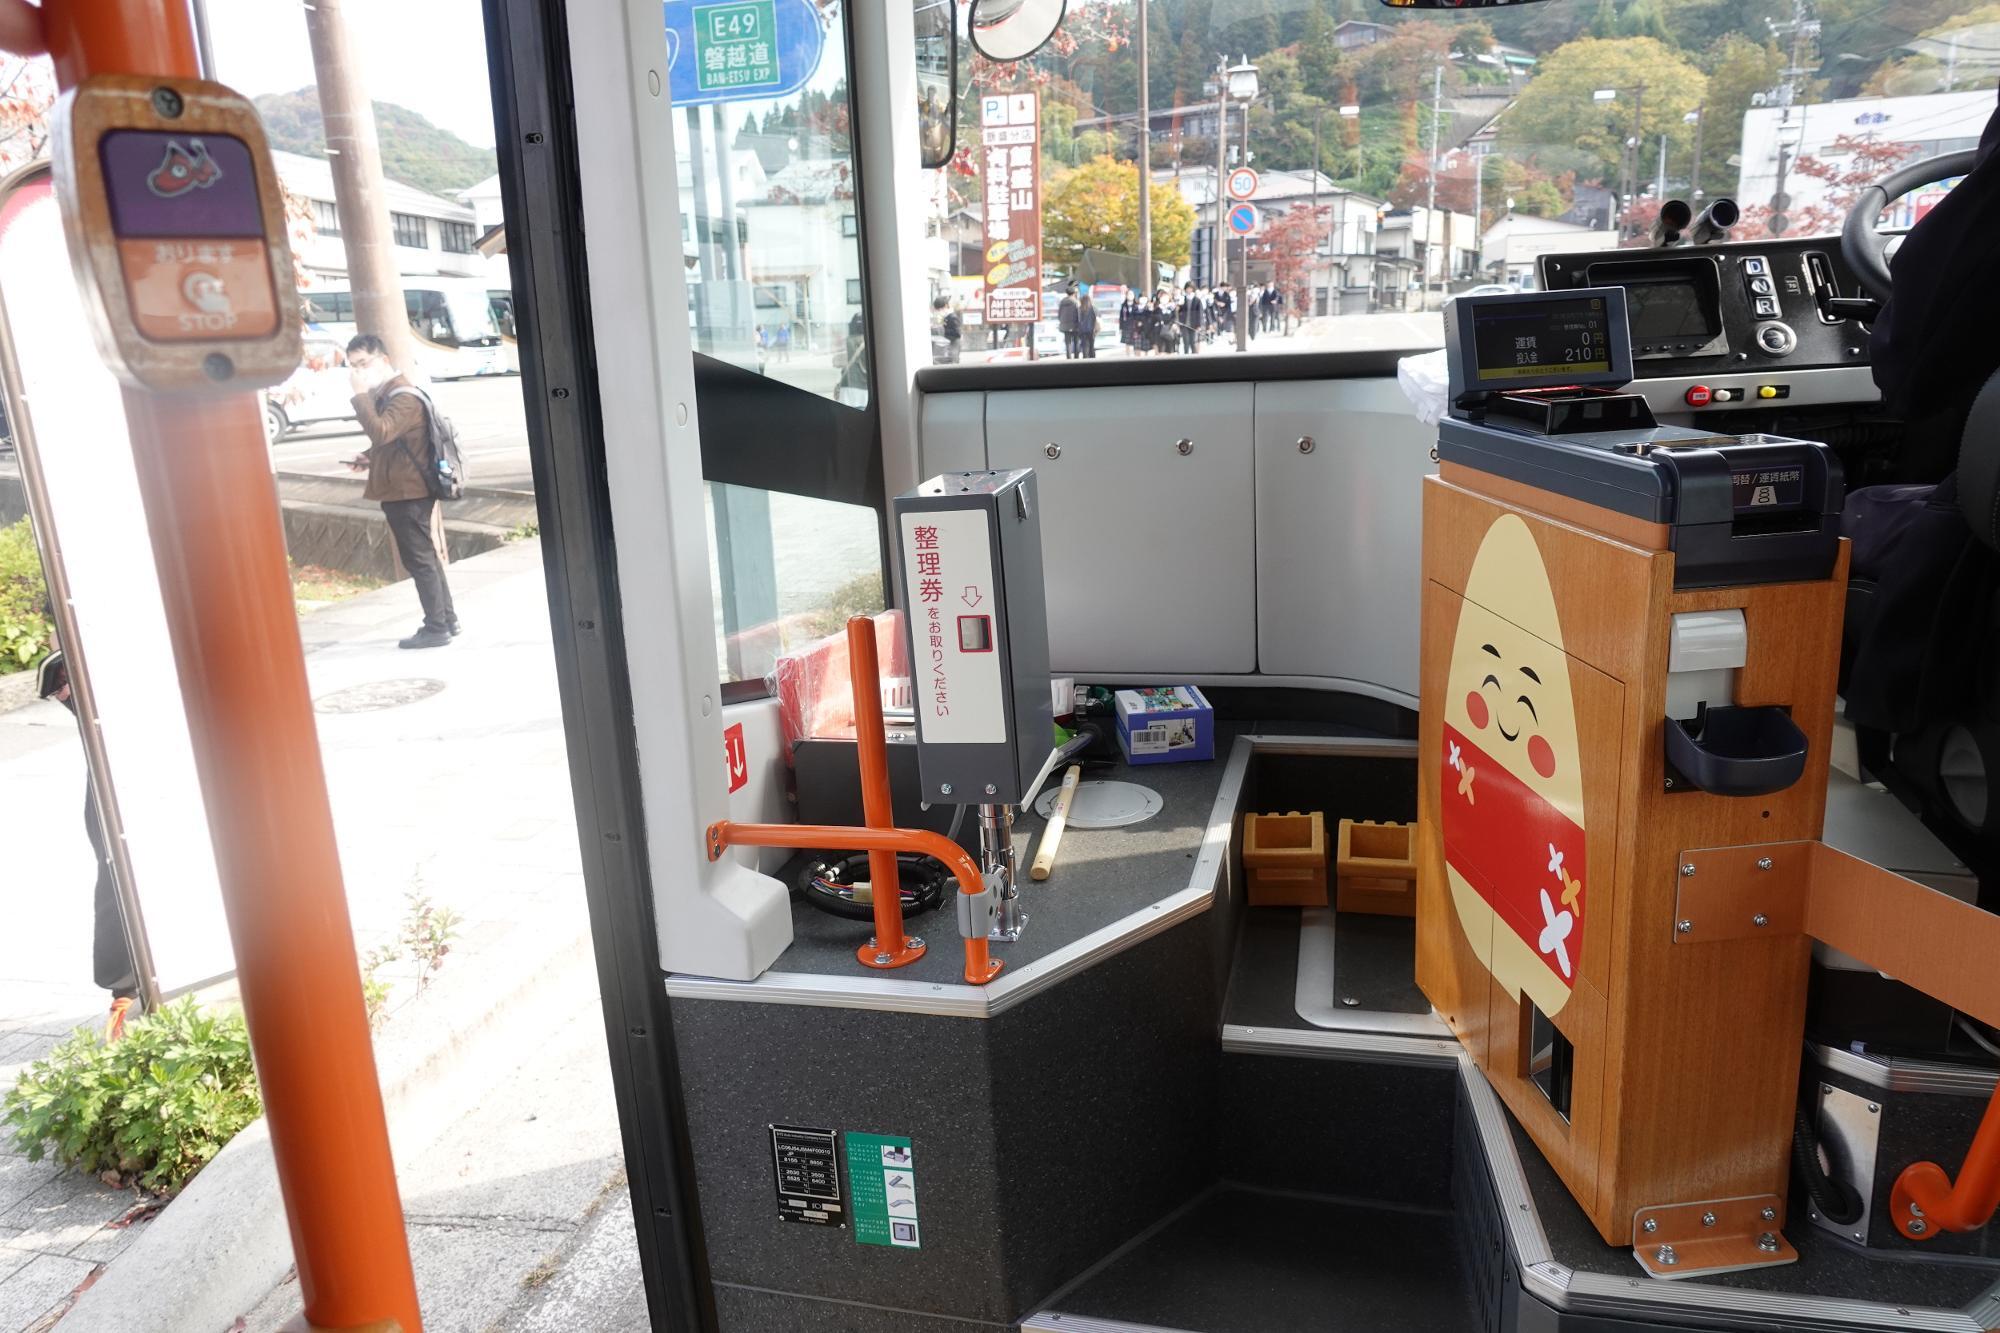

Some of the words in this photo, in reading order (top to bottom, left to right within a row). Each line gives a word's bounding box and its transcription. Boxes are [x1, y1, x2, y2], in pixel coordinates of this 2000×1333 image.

[714, 13, 755, 37] E49
[704, 42, 770, 71] 磐越道
[706, 69, 750, 86] BAN-ETSU
[753, 67, 770, 82] EXP
[1234, 176, 1252, 191] 50
[1751, 261, 1764, 275] D
[1755, 279, 1769, 292] N
[1760, 299, 1773, 314] R
[178, 312, 238, 331] STOP
[1588, 320, 1598, 330] 01
[1515, 335, 1537, 349] 運賃
[1516, 351, 1539, 365] 投入金
[913, 525, 950, 718] 整理券をお取りください
